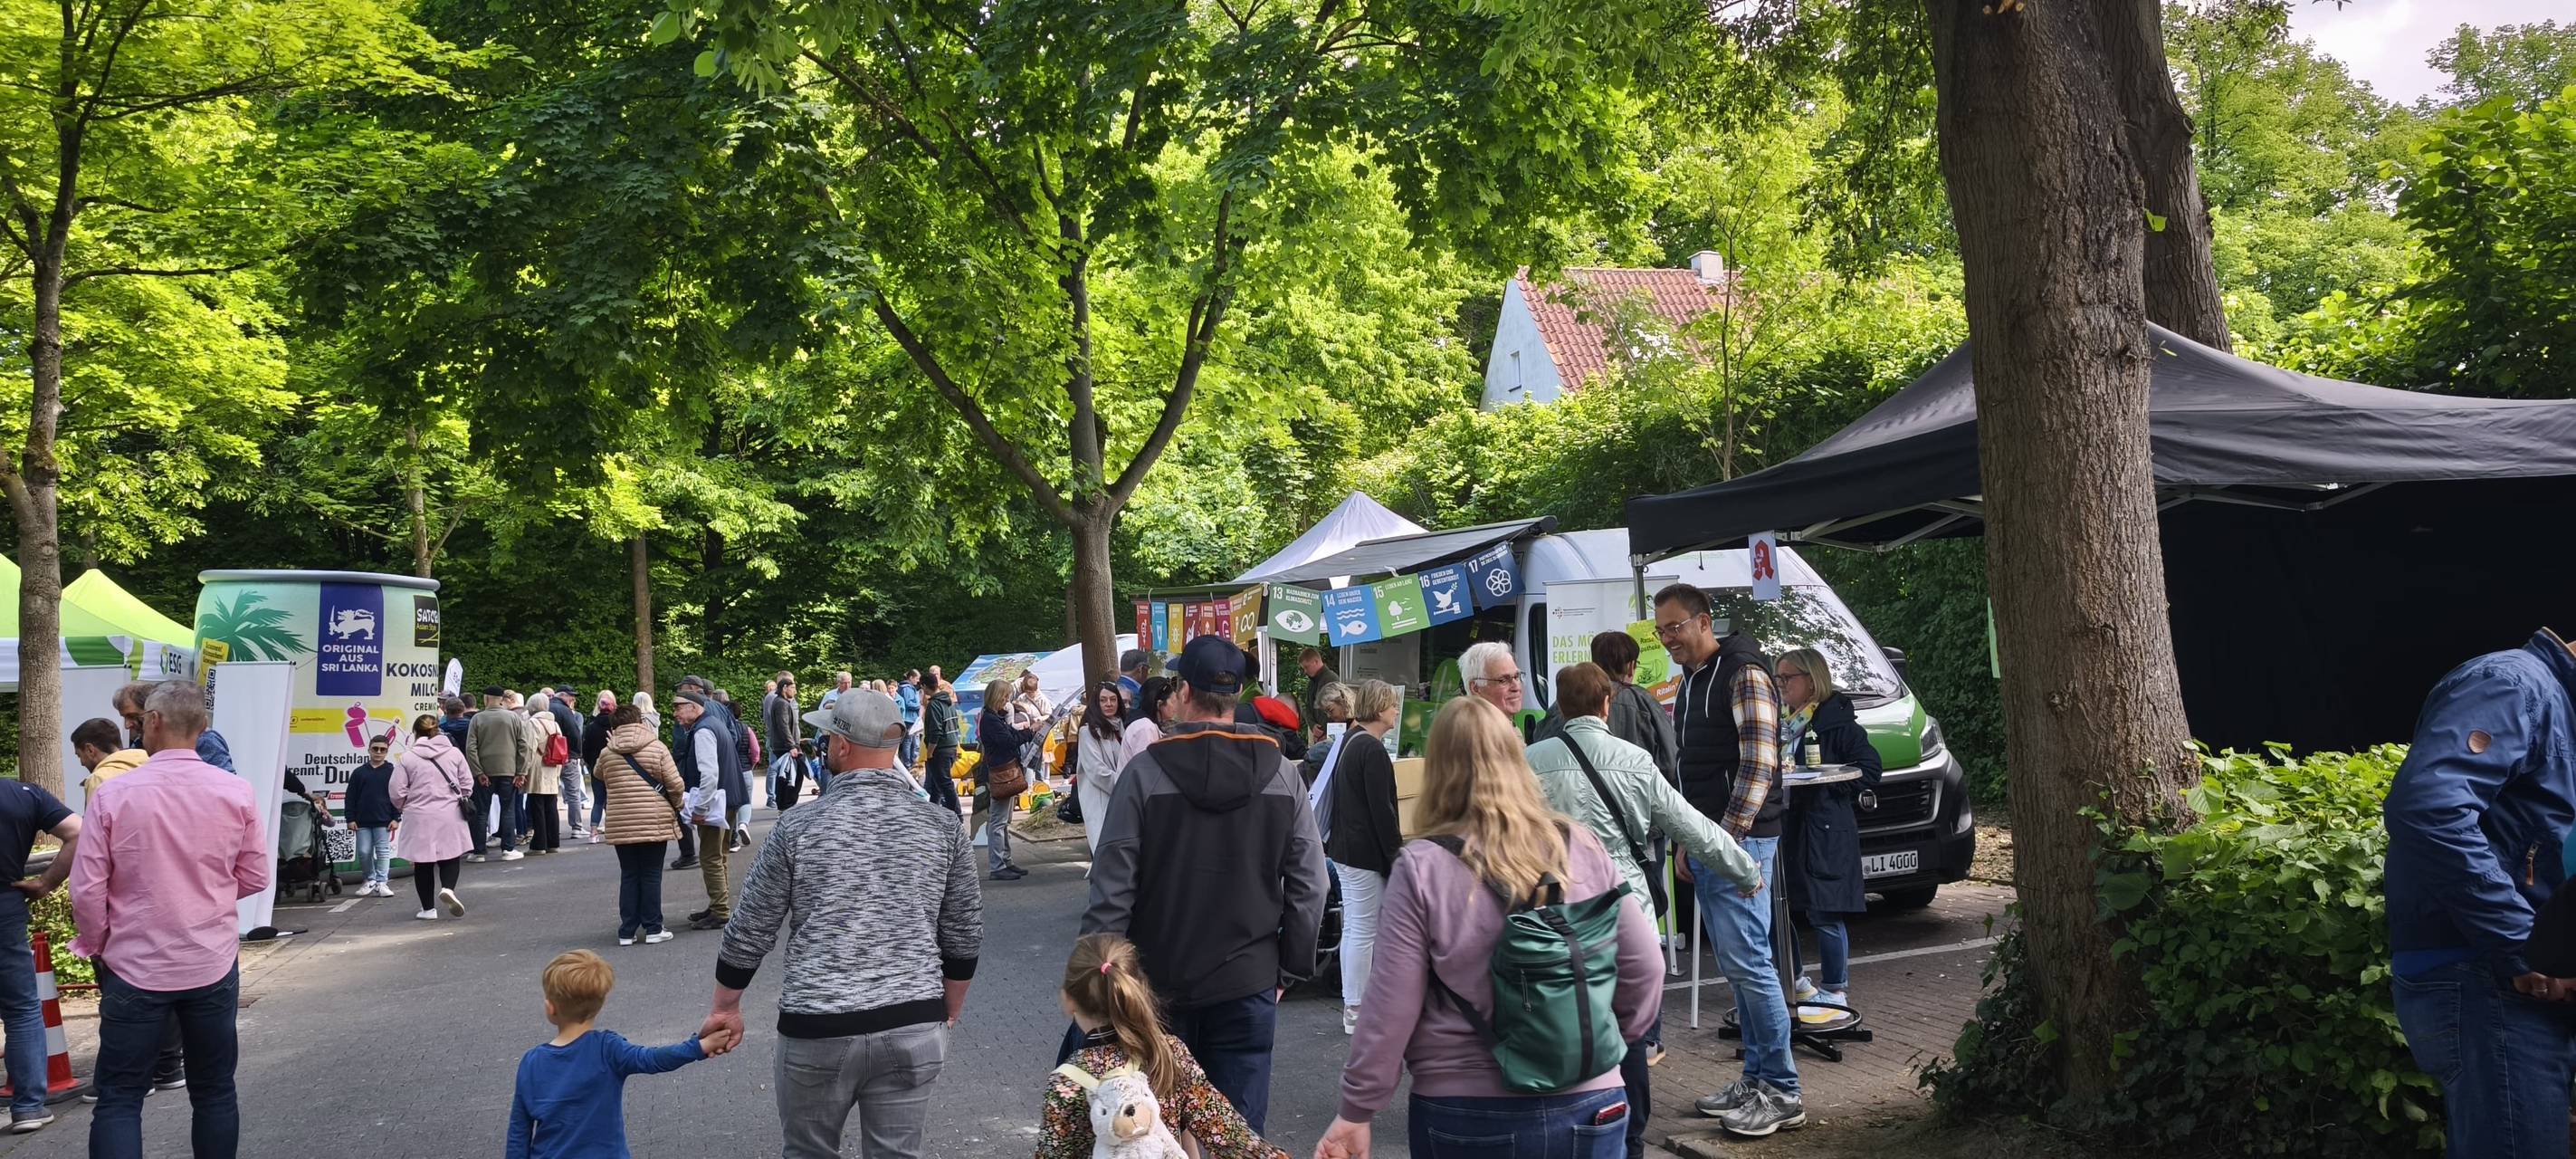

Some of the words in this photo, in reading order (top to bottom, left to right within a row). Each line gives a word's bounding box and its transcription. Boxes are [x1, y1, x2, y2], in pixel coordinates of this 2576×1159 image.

[1468, 559, 1478, 573] 17
[1419, 574, 1430, 589] 16
[1273, 586, 1283, 599] 13
[1373, 585, 1385, 599] 15
[1324, 593, 1336, 608] 14
[1552, 635, 1573, 648] DAS
[322, 644, 379, 654] ORIGINAL
[168, 652, 182, 675] ESG
[339, 654, 364, 663] AUS
[321, 663, 339, 672] SRI
[342, 663, 379, 673] LANKA
[386, 663, 439, 677] KOKOSN
[304, 752, 370, 765] Deutschlan
[287, 765, 324, 776] rennt.
[1871, 856, 1886, 872] LI
[1889, 853, 1917, 870] 4000
